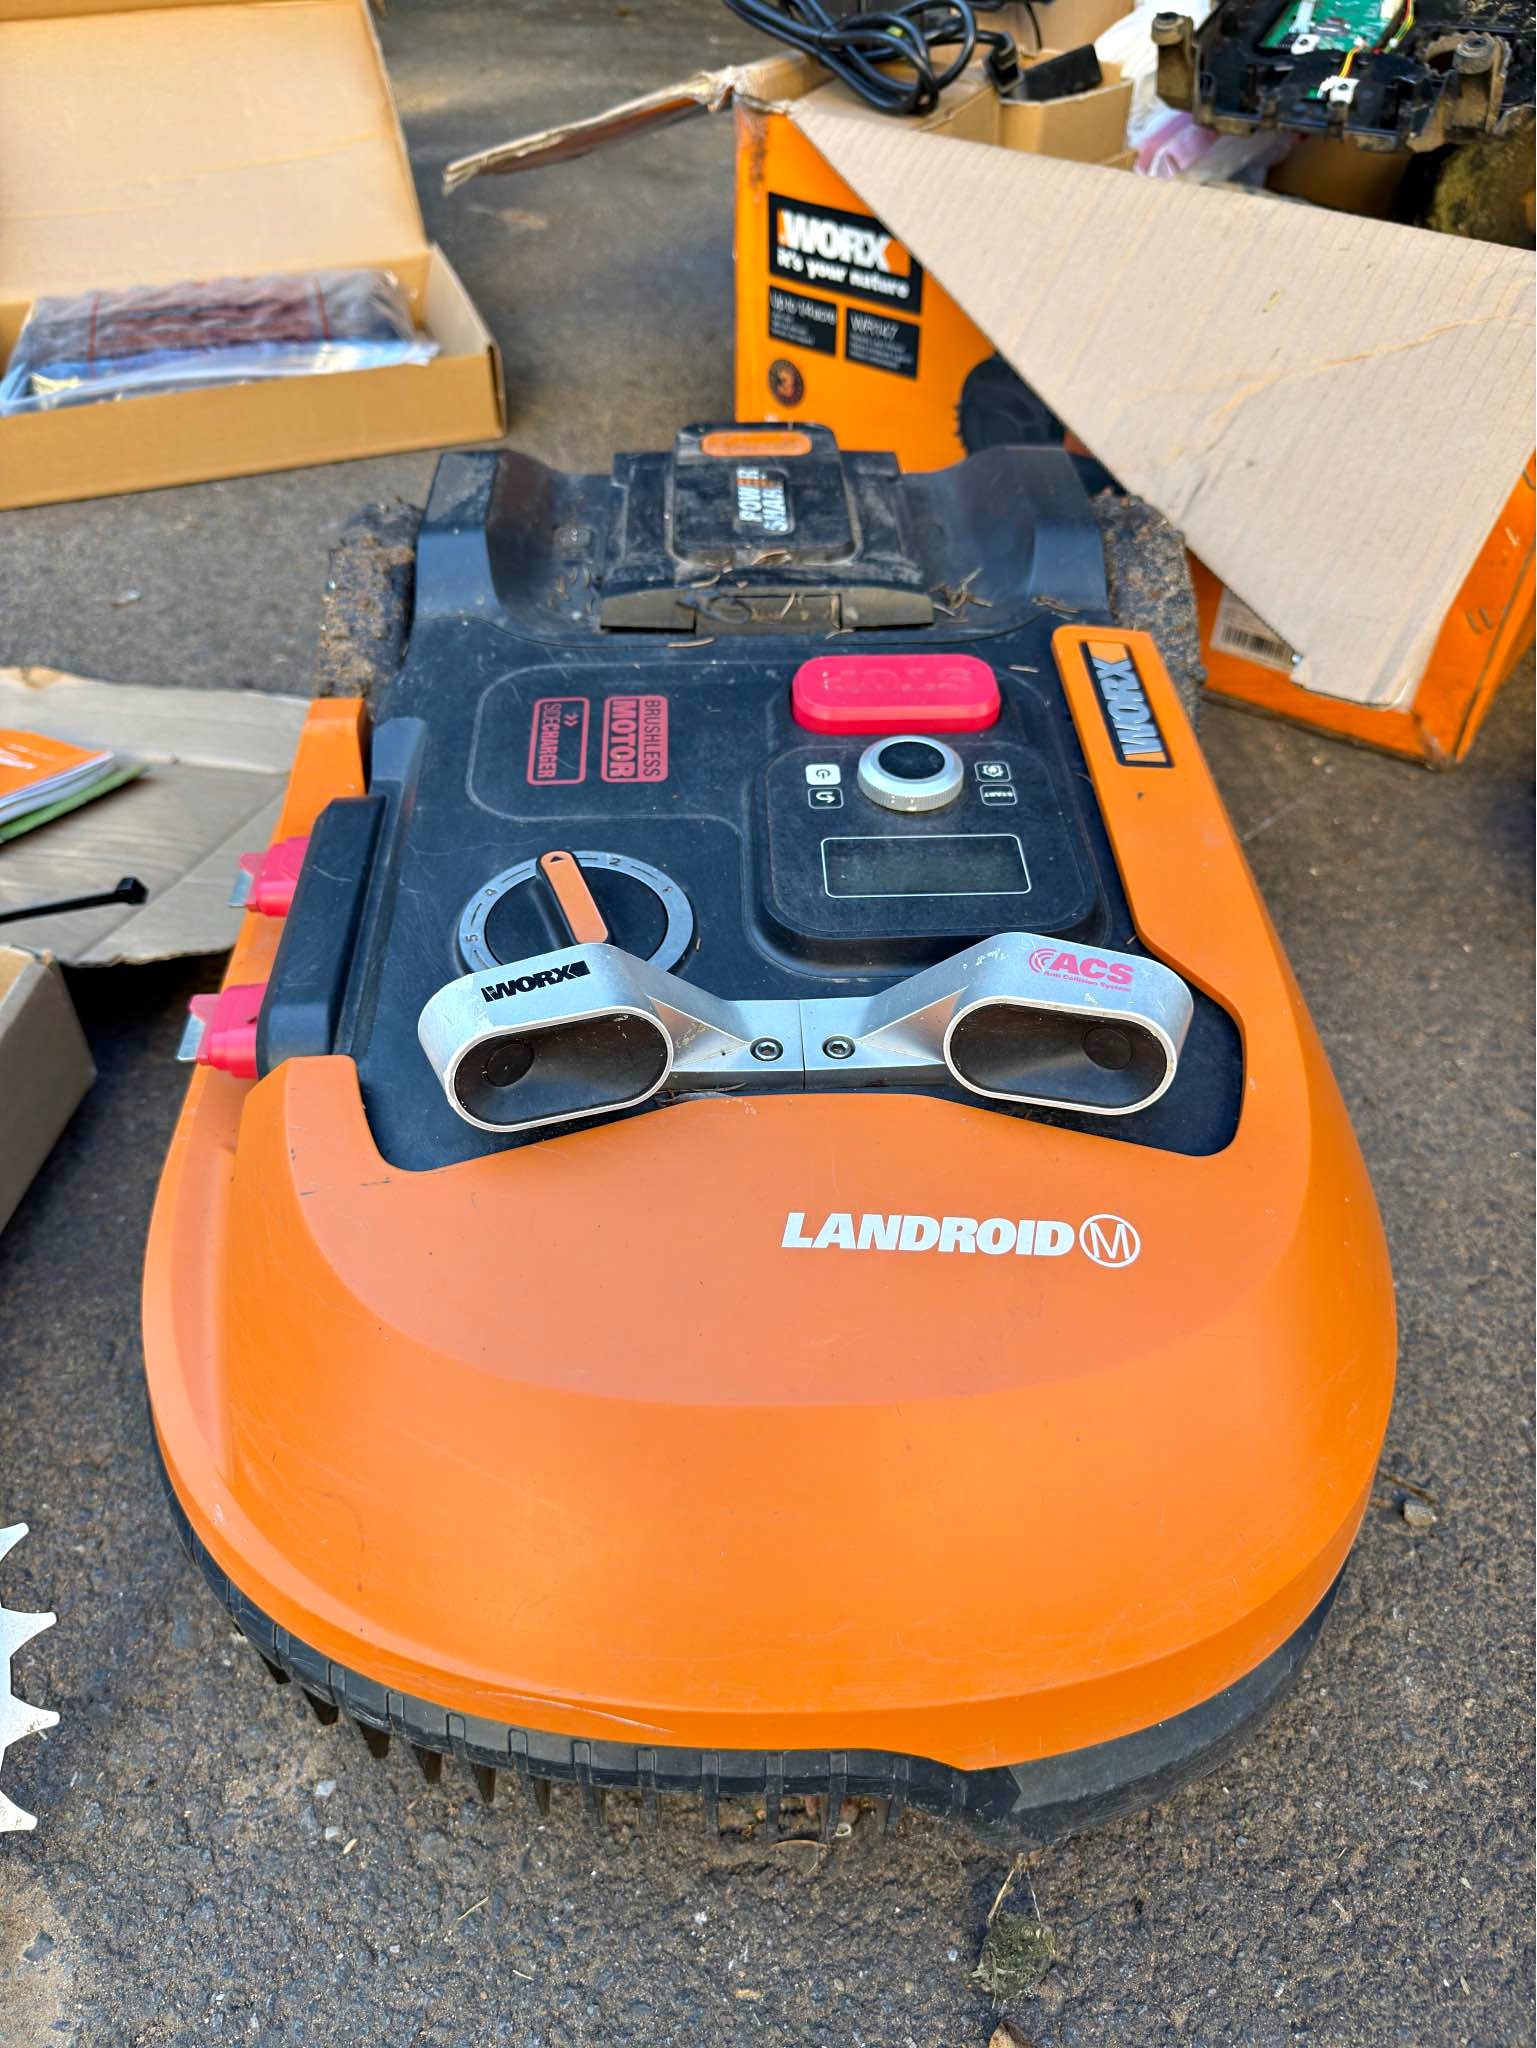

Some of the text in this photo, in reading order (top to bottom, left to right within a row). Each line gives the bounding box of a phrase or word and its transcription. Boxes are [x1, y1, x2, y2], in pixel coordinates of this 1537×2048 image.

[778, 209, 900, 275] WORX
[806, 258, 848, 283] your
[849, 271, 910, 299] nature
[1090, 655, 1166, 757] WORX
[536, 702, 563, 779] SIDECHARGER
[609, 699, 638, 780] MOTOR
[643, 699, 662, 777] BRUSHLESS
[606, 857, 621, 867] 2
[464, 933, 479, 943] 5
[482, 961, 586, 1003] WORX
[1049, 952, 1136, 985] ACS
[781, 1211, 1132, 1261] LANDROID M
